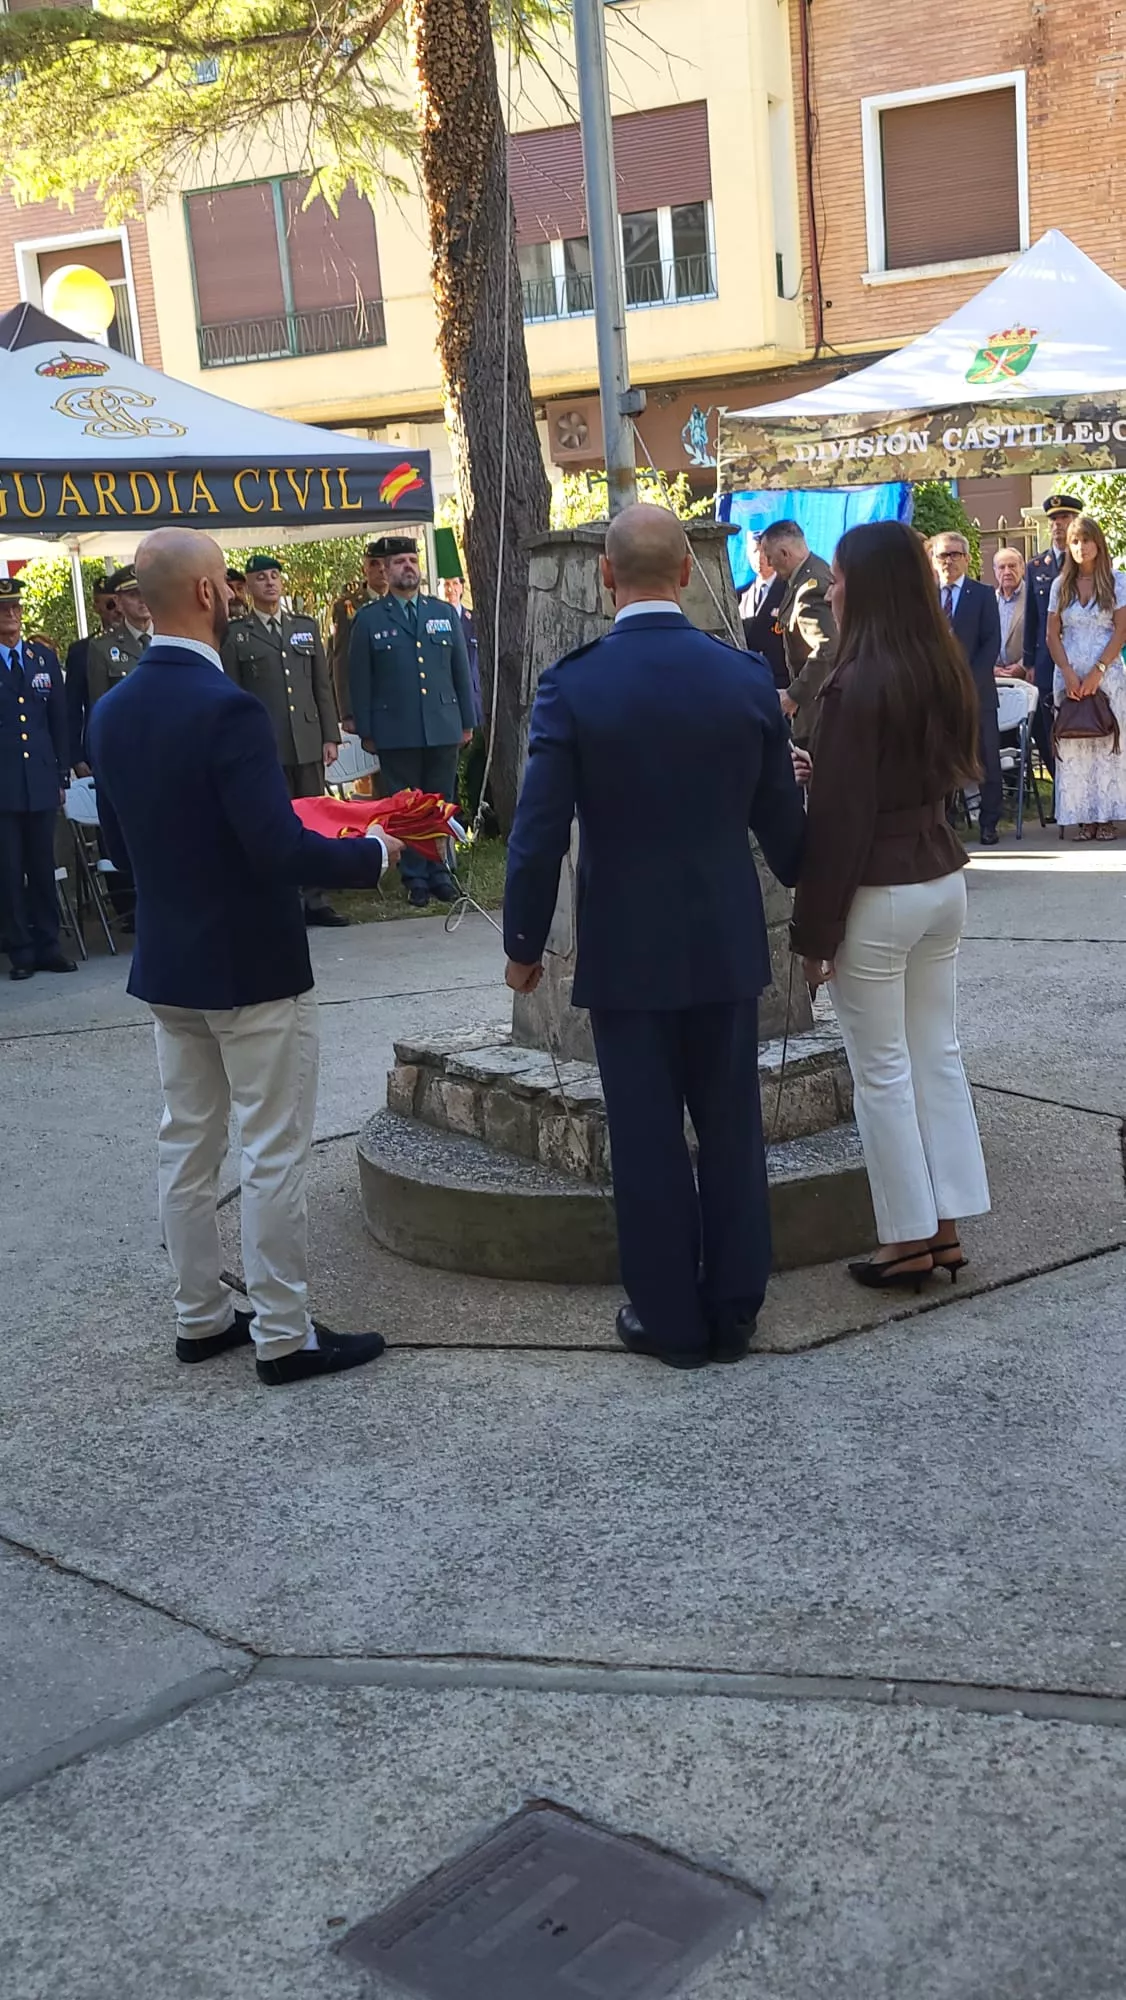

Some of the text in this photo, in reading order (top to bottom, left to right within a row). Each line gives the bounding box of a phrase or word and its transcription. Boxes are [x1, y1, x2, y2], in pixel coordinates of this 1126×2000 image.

[793, 426, 930, 462] DIVISIÓN
[0, 467, 363, 518] UARDIA CIVIL
